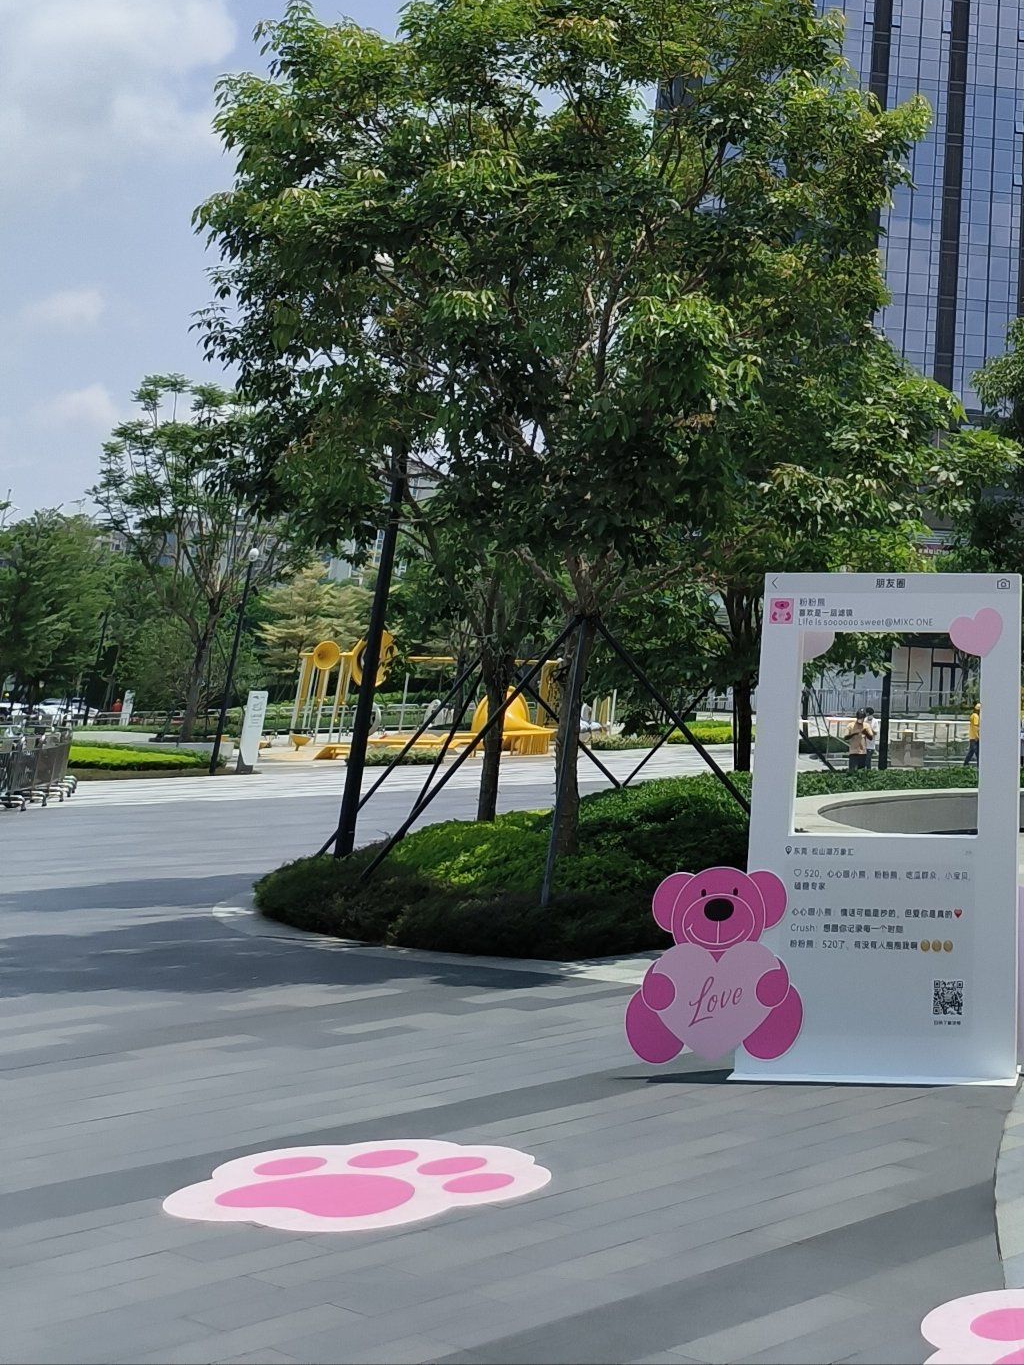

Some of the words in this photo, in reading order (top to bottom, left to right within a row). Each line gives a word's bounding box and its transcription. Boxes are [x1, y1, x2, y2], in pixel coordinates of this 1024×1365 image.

[875, 578, 906, 589] 朋友圈
[799, 598, 826, 607] 粉粉熊
[798, 608, 853, 617] 喜欢是一层滤镜
[798, 618, 813, 626] Life
[916, 618, 934, 626] ONE
[688, 976, 743, 1027] Love
